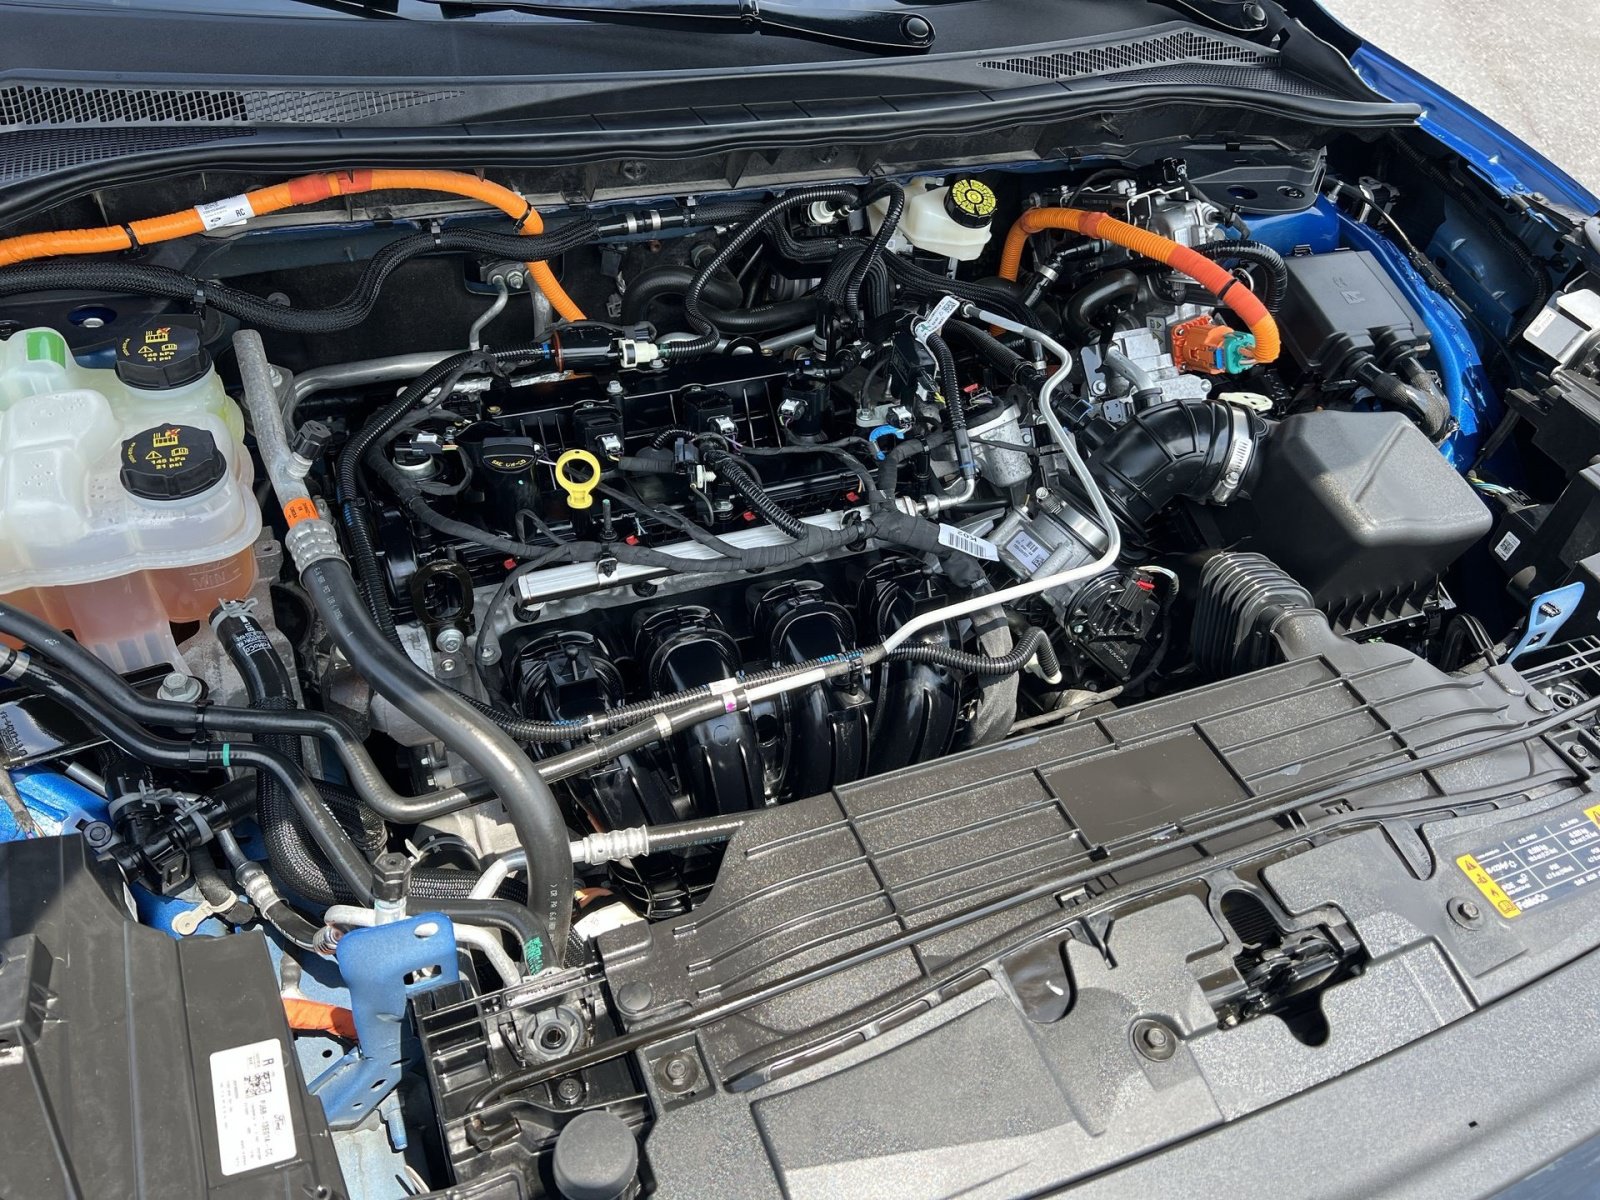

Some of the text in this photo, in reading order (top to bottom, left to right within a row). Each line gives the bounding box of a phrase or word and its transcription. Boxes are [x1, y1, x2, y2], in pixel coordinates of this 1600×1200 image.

[236, 208, 246, 217] RC
[957, 531, 978, 542] K02
[192, 570, 226, 588] MIN
[262, 1057, 275, 1067] R
